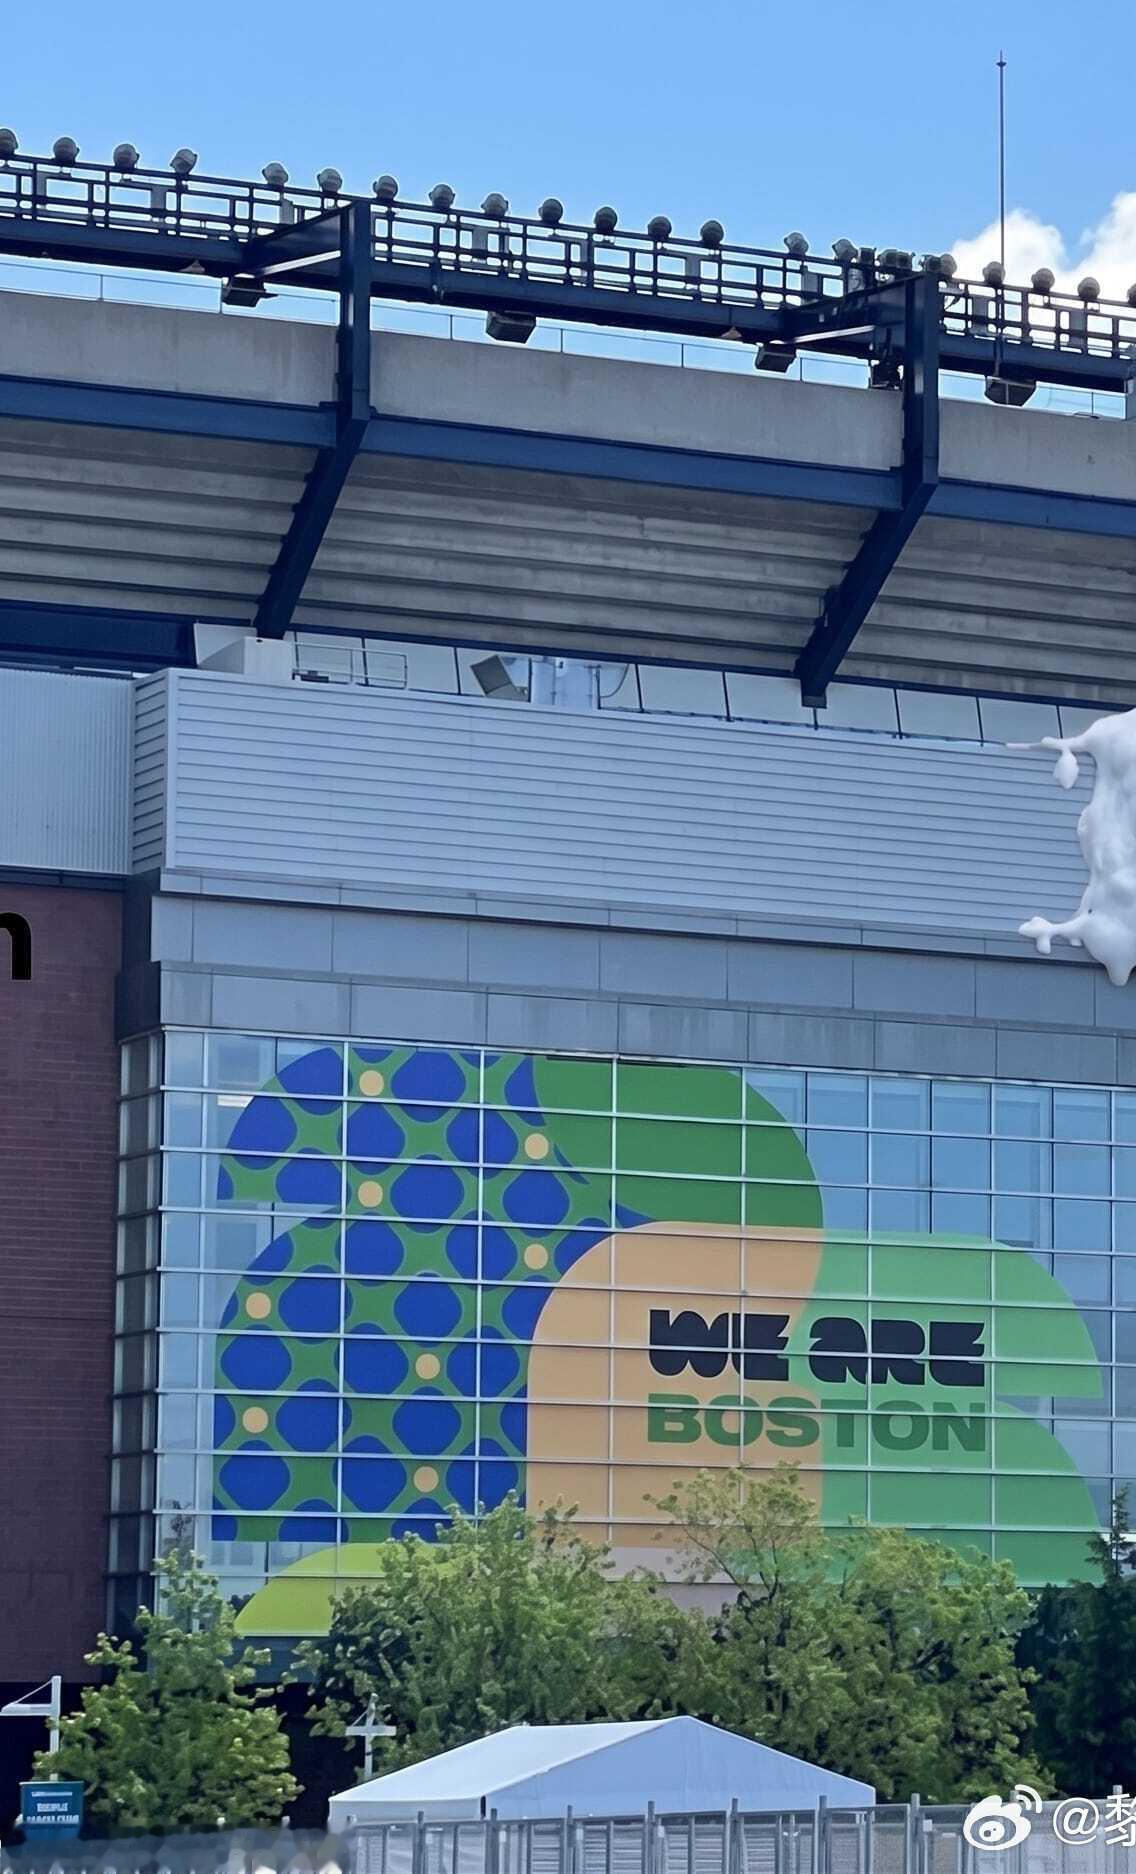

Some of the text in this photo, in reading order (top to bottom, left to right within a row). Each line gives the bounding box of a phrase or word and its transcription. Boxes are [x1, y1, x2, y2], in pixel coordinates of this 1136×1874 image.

[649, 1309, 985, 1386] WE ARE
[648, 1393, 985, 1452] BOSTON
